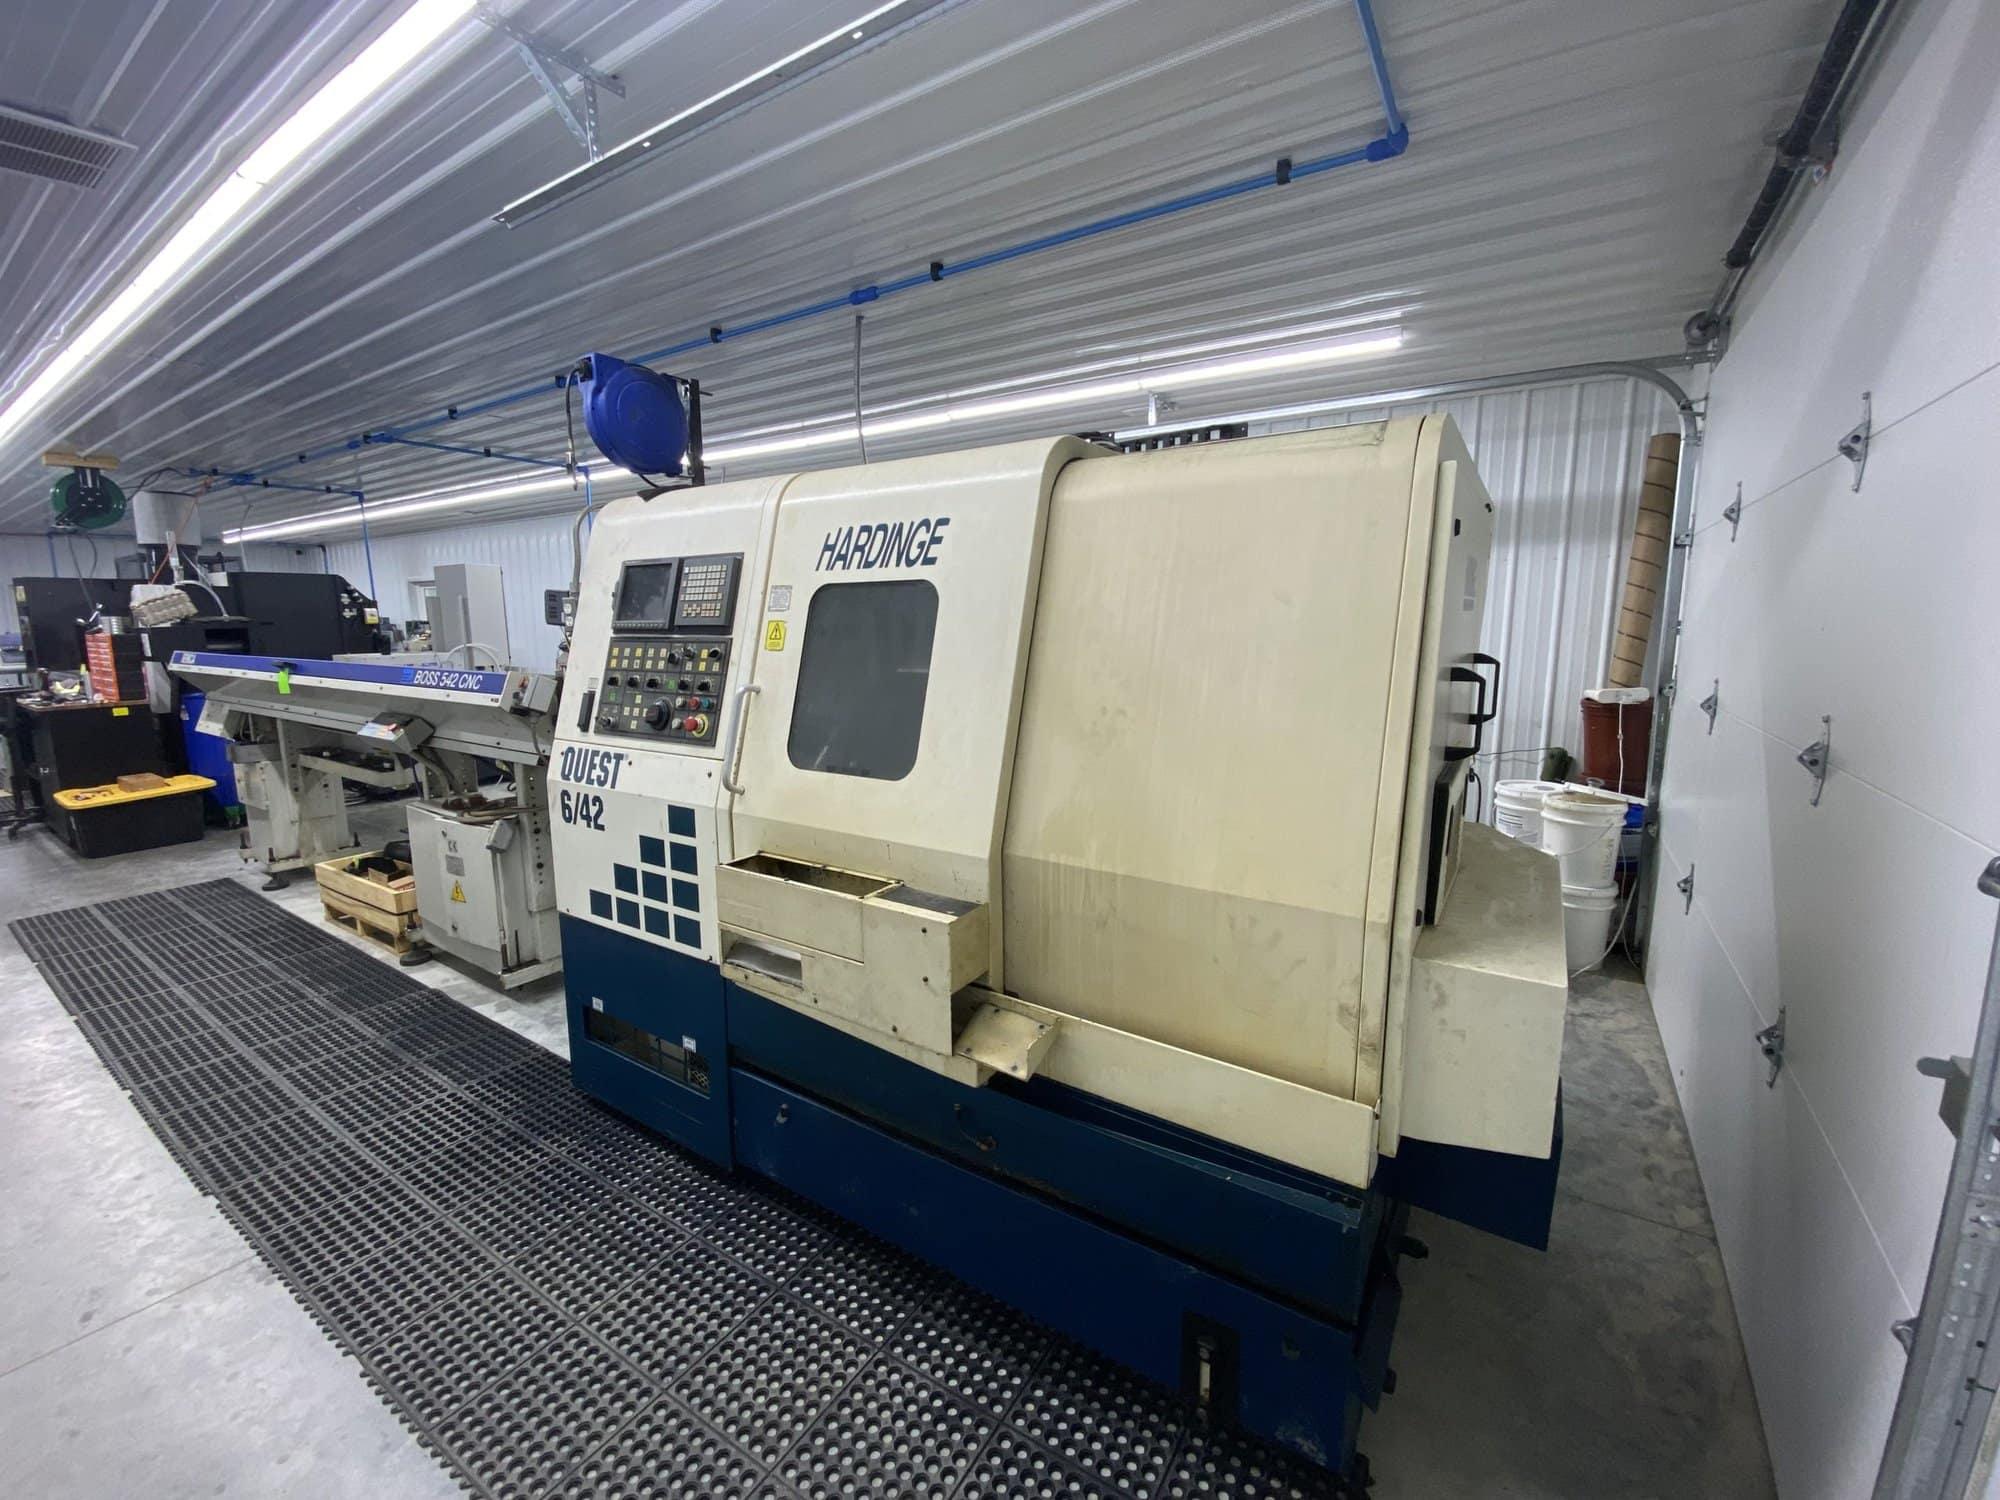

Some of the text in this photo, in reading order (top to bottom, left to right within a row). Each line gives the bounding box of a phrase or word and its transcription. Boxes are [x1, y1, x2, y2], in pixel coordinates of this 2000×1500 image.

[815, 517, 951, 571] HARDINGE
[413, 670, 483, 690] BOSS 542 CNC
[561, 746, 624, 789] QUEST
[560, 789, 605, 832] 6/42
